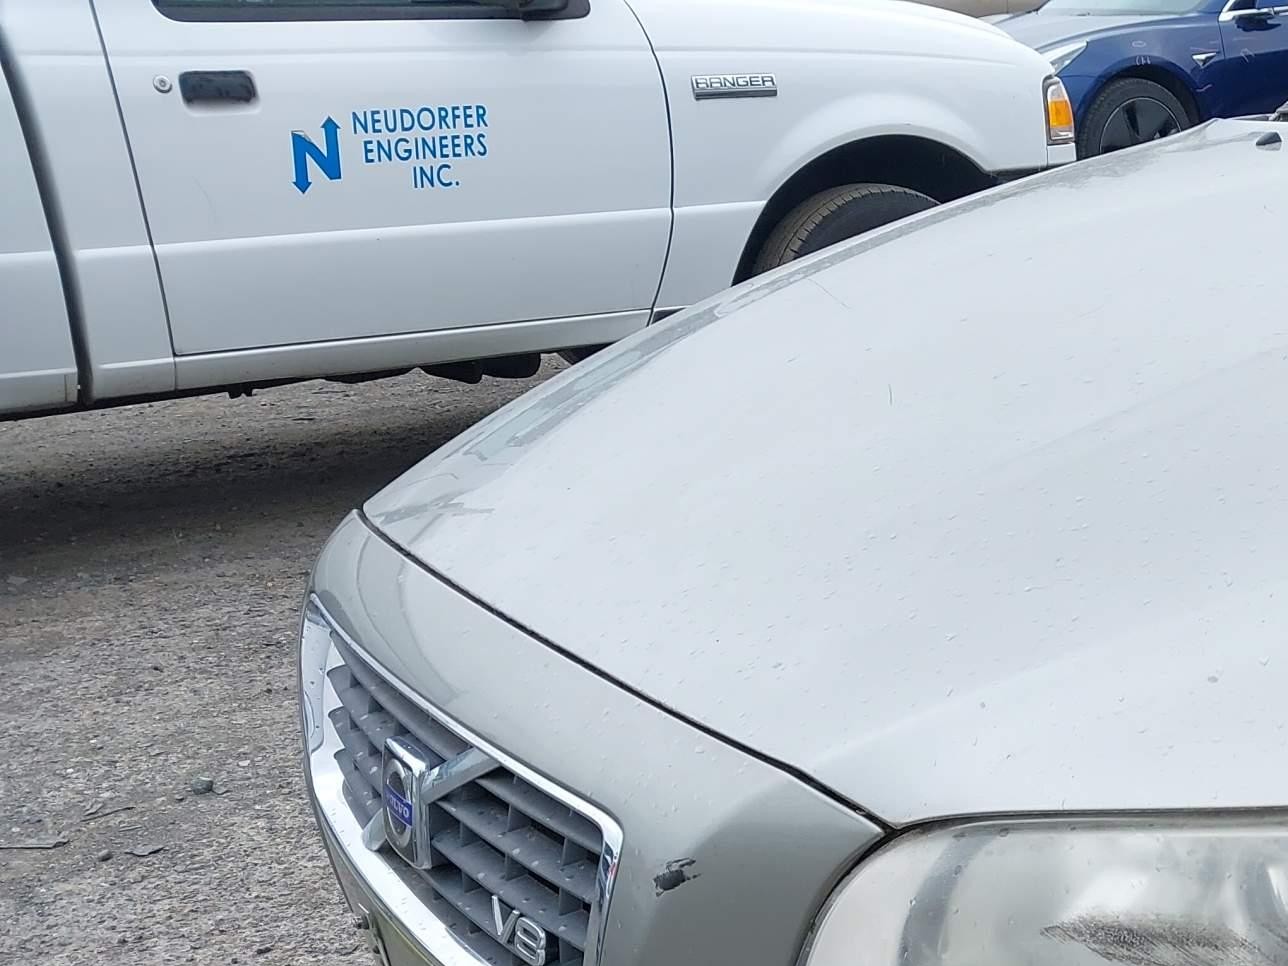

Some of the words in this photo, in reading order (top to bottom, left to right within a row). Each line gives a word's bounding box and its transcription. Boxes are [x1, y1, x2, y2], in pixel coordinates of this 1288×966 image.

[694, 75, 776, 89] RANGER
[352, 105, 488, 134] NEUDORFER
[363, 133, 488, 163] ENGINEERS
[413, 164, 460, 188] INC.
[491, 895, 546, 966] V8
